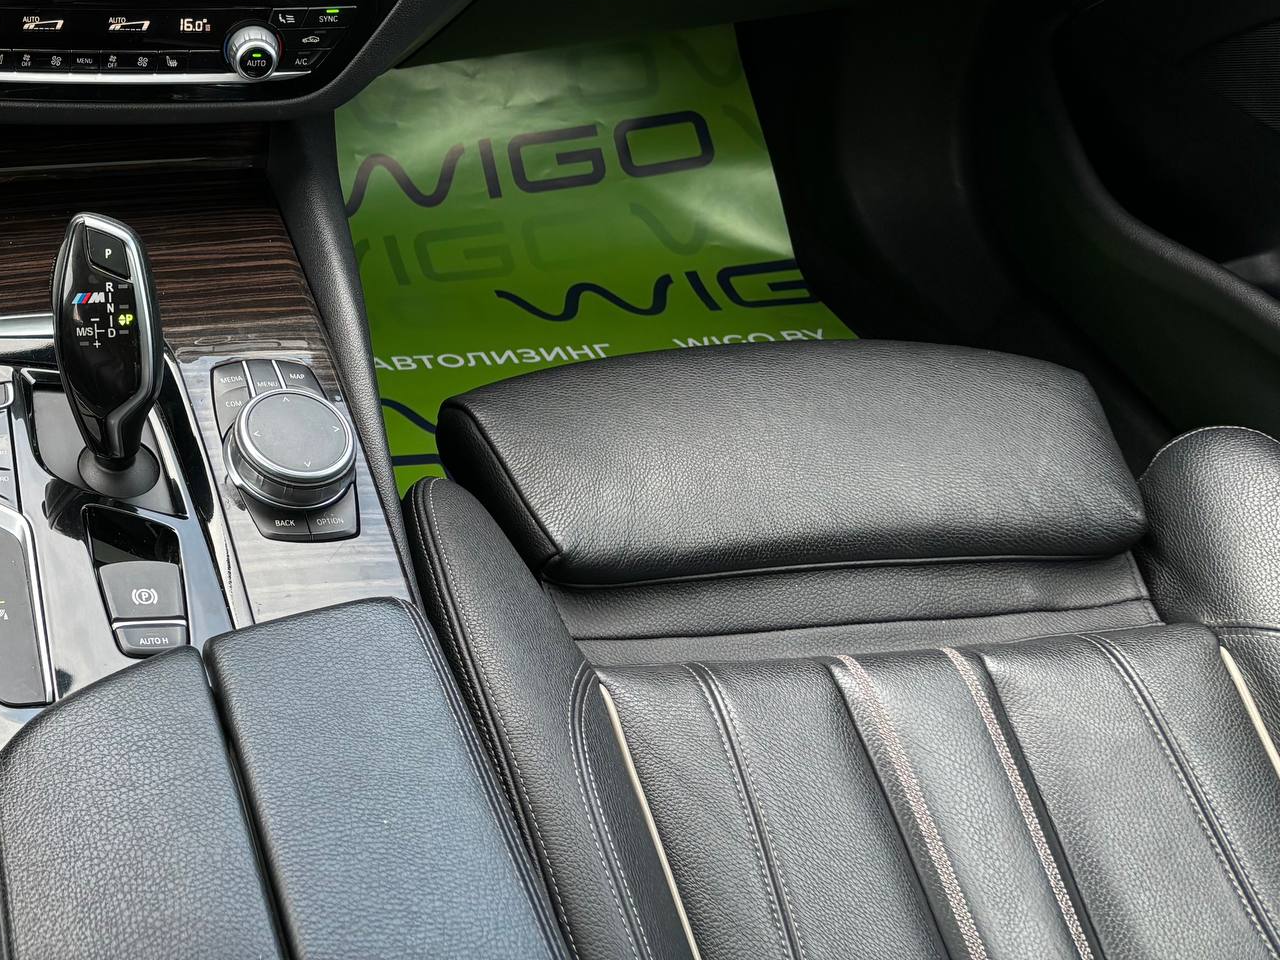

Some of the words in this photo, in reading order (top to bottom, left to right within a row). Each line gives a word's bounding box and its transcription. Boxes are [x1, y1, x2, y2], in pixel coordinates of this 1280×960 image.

[108, 16, 126, 24] AUTO
[319, 15, 339, 23] SYNC
[246, 59, 266, 67] AUTO
[295, 58, 308, 66] A/C
[104, 248, 112, 259] P
[105, 282, 114, 292] R
[107, 303, 115, 313] N
[76, 326, 94, 337] M/S
[108, 328, 116, 338] D
[374, 343, 610, 371] АВТОЛИЗИНГ
[220, 375, 243, 383] MEDIA
[275, 519, 296, 527] BACK
[316, 517, 344, 525] OPTION
[140, 637, 160, 645] AUTO
